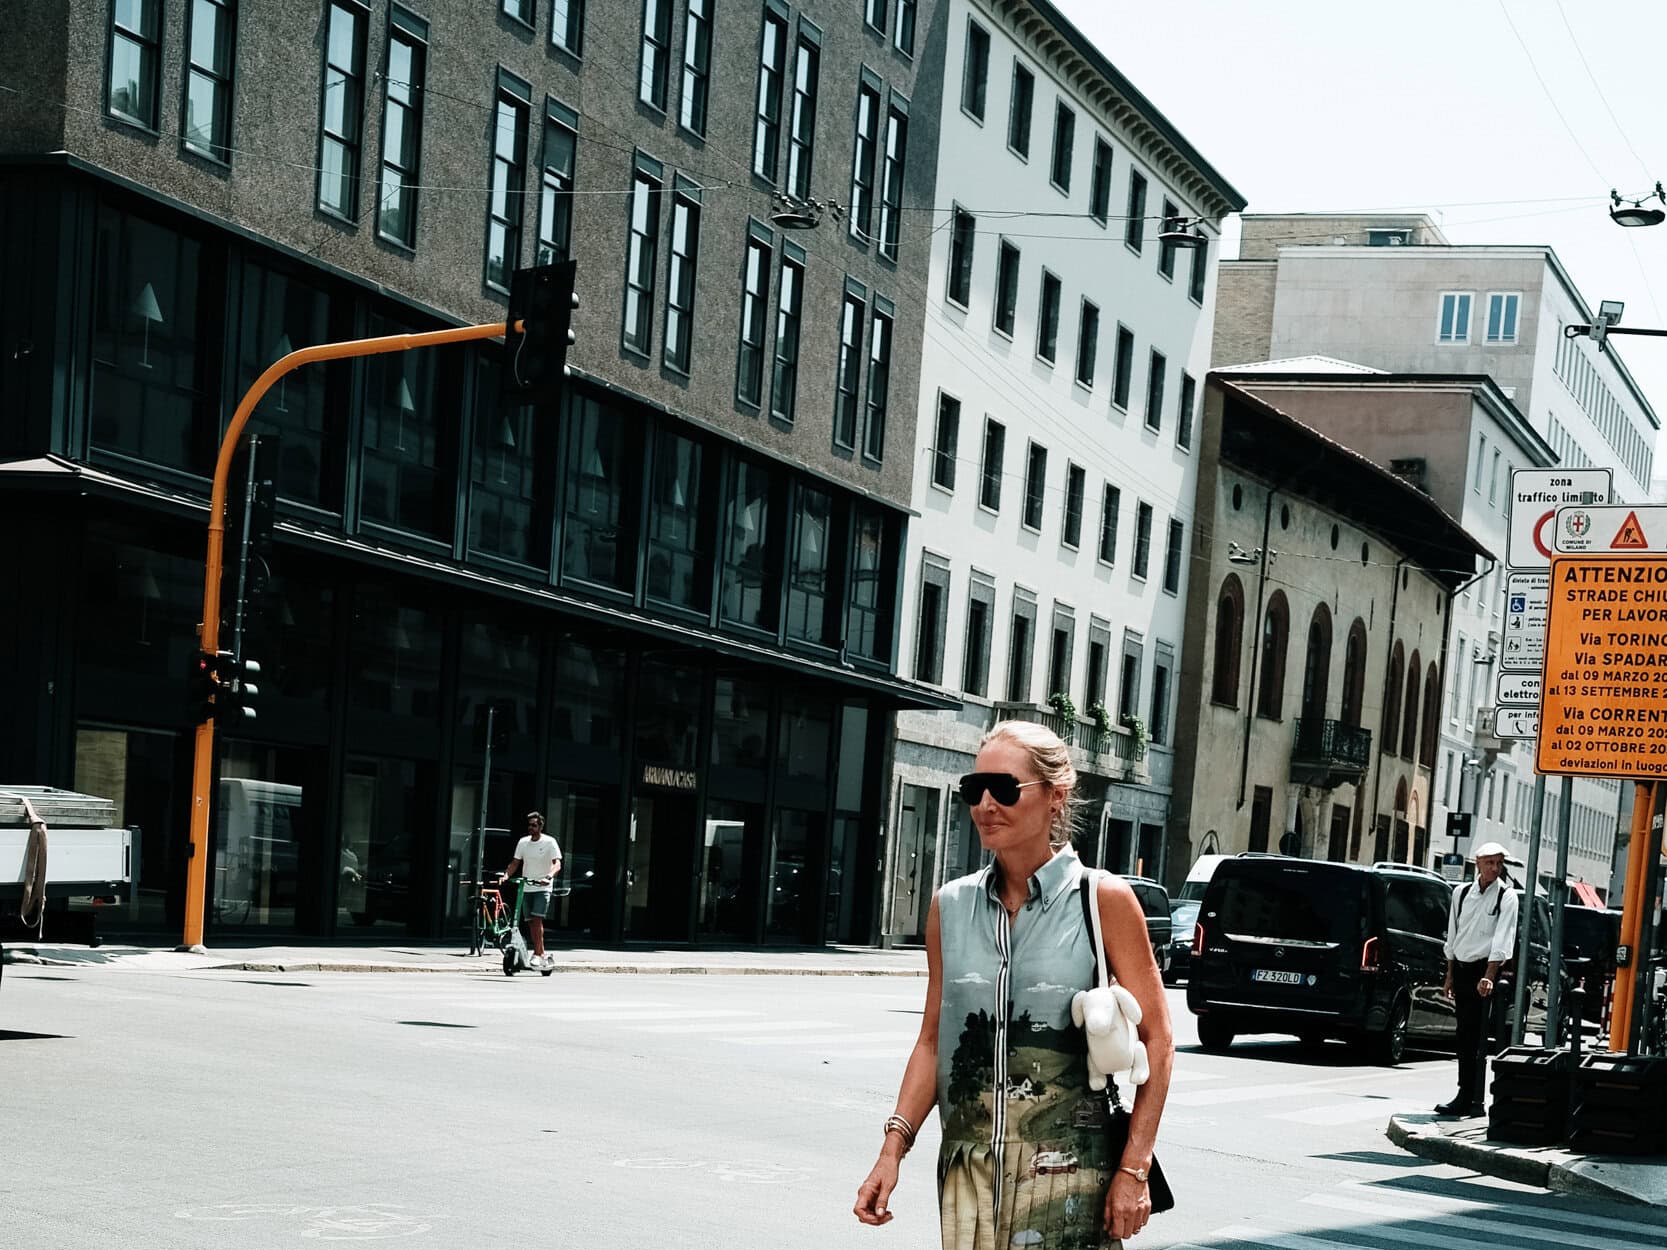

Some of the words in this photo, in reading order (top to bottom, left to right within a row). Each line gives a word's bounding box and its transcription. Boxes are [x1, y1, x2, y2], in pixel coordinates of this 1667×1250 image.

[1550, 478, 1572, 487] zona
[1518, 491, 1558, 502] traffico
[1562, 491, 1604, 502] limito
[1565, 566, 1667, 583] ATTENZIO
[1567, 589, 1628, 602] STRADE
[1582, 609, 1612, 621] PER
[1618, 609, 1667, 622] LAVOR
[1580, 633, 1601, 646] Via
[1575, 652, 1596, 665] Via
[1602, 653, 1667, 667] SPADAR
[1560, 670, 1579, 681] dal
[1583, 670, 1599, 681] 09
[1603, 671, 1649, 682] MARZO
[1503, 689, 1539, 699] elettro
[1549, 685, 1560, 696] al
[1564, 685, 1577, 696] 13
[1581, 686, 1659, 698] SETTEMBRE
[1563, 707, 1584, 720] Via
[1590, 708, 1667, 722] CORRENT
[1556, 725, 1574, 735] dal
[1578, 725, 1594, 736] 09
[1598, 726, 1644, 737] MARZO
[1552, 740, 1562, 750] al
[1566, 740, 1581, 750] 02
[1586, 741, 1646, 753] OTTOBRE
[1560, 757, 1617, 769] deviazioni
[1621, 759, 1632, 770] in
